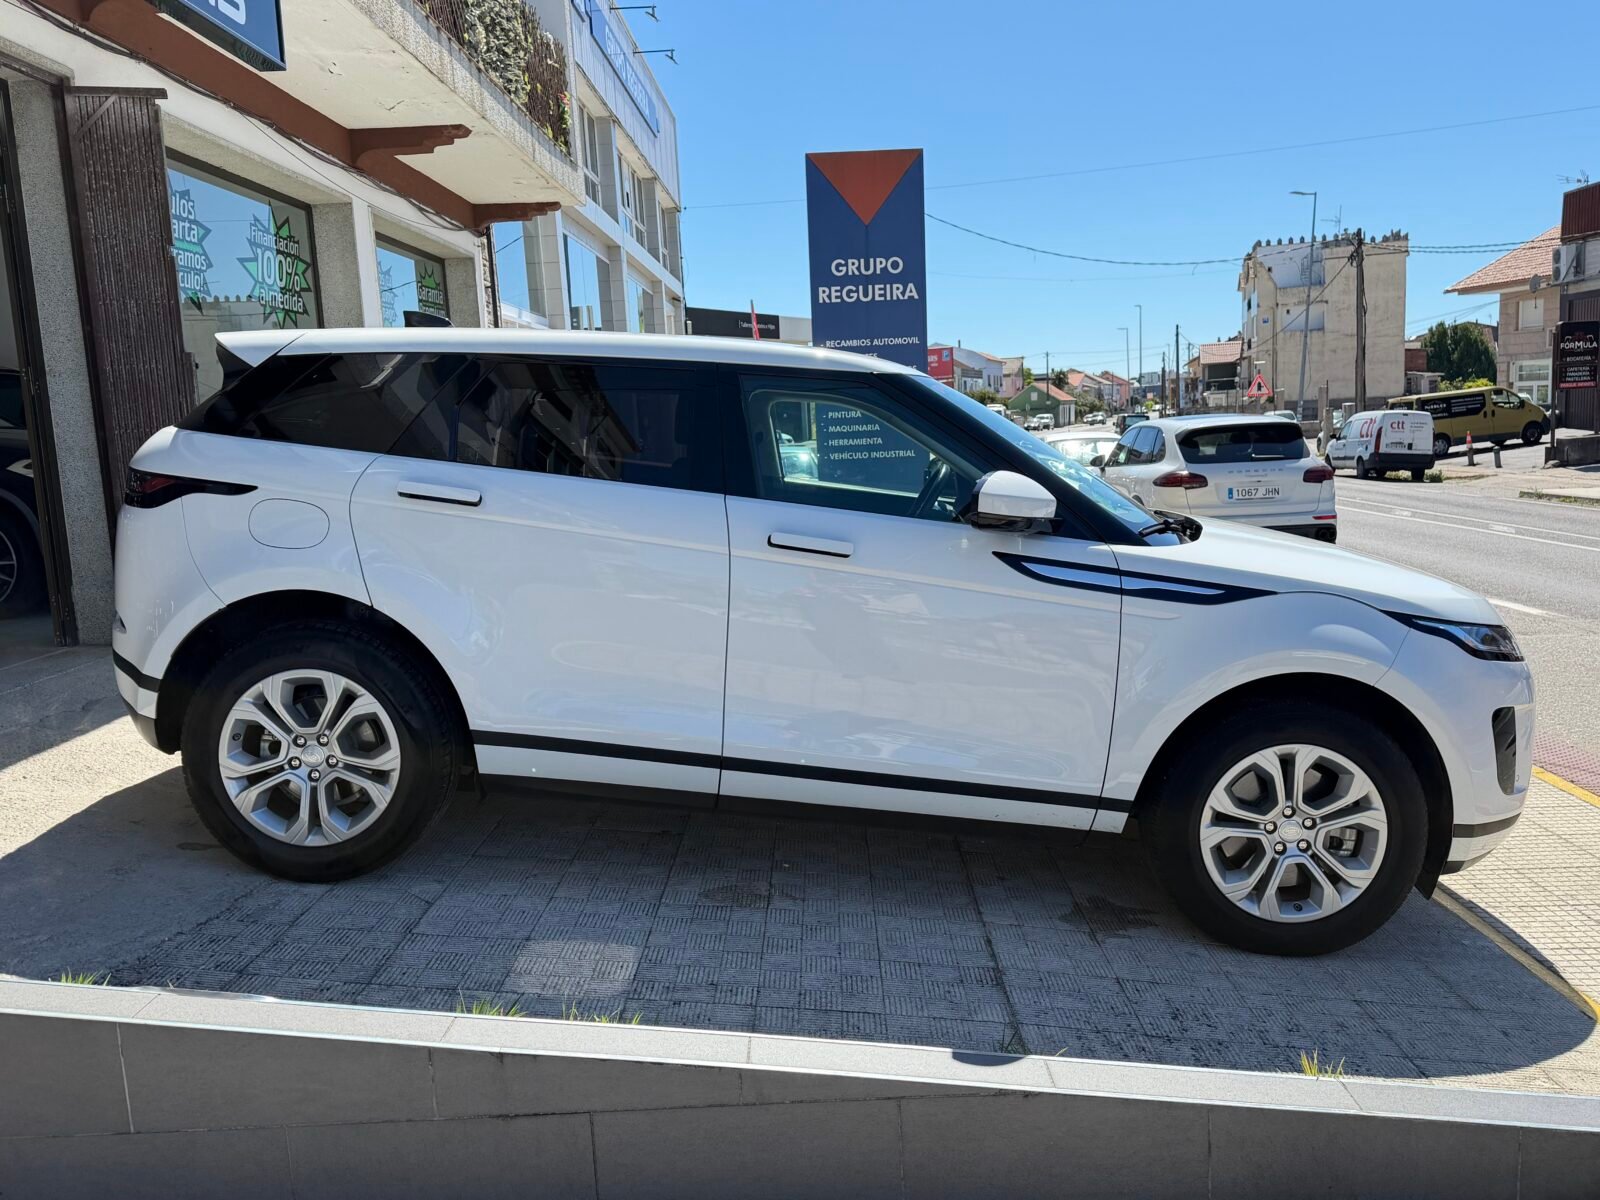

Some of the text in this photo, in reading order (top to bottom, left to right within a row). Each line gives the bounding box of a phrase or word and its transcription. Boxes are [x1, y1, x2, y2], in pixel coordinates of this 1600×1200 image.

[256, 249, 300, 291] 100%
[831, 257, 904, 276] GRUPO
[818, 283, 919, 303] REGUEIRA
[259, 287, 303, 312] a medida
[825, 336, 920, 348] RECAMBIOS AUTOMOVIL
[828, 410, 862, 419] PINTURA
[828, 423, 880, 433] MAQUINARIA
[1390, 420, 1405, 430] ctt
[828, 437, 883, 447] HERRAMIENTA
[870, 450, 916, 458] INDUSTRIAL
[1236, 487, 1280, 497] 1067 JHN
